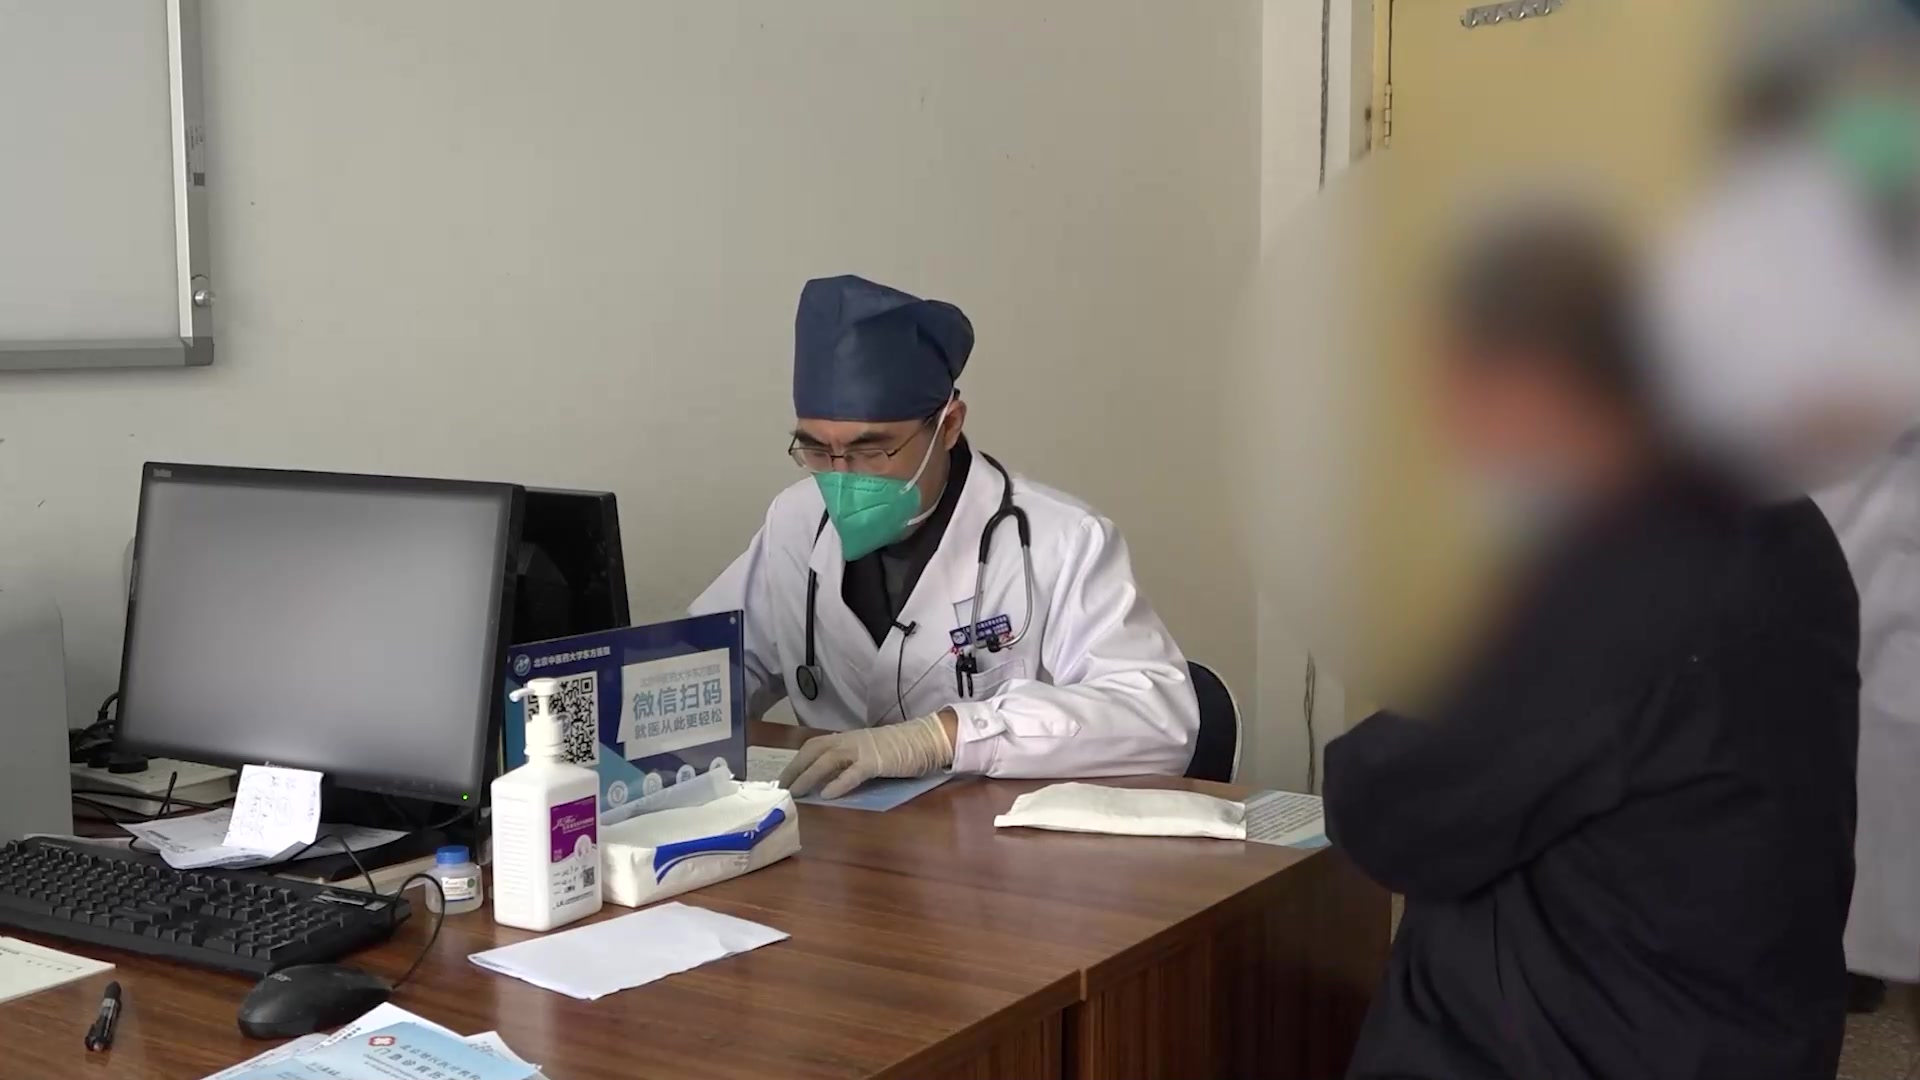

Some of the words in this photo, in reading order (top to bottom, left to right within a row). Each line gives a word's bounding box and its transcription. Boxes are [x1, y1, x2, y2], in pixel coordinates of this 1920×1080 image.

[633, 678, 722, 720] 微信扫码
[634, 708, 722, 739] 就医从此更轻松
